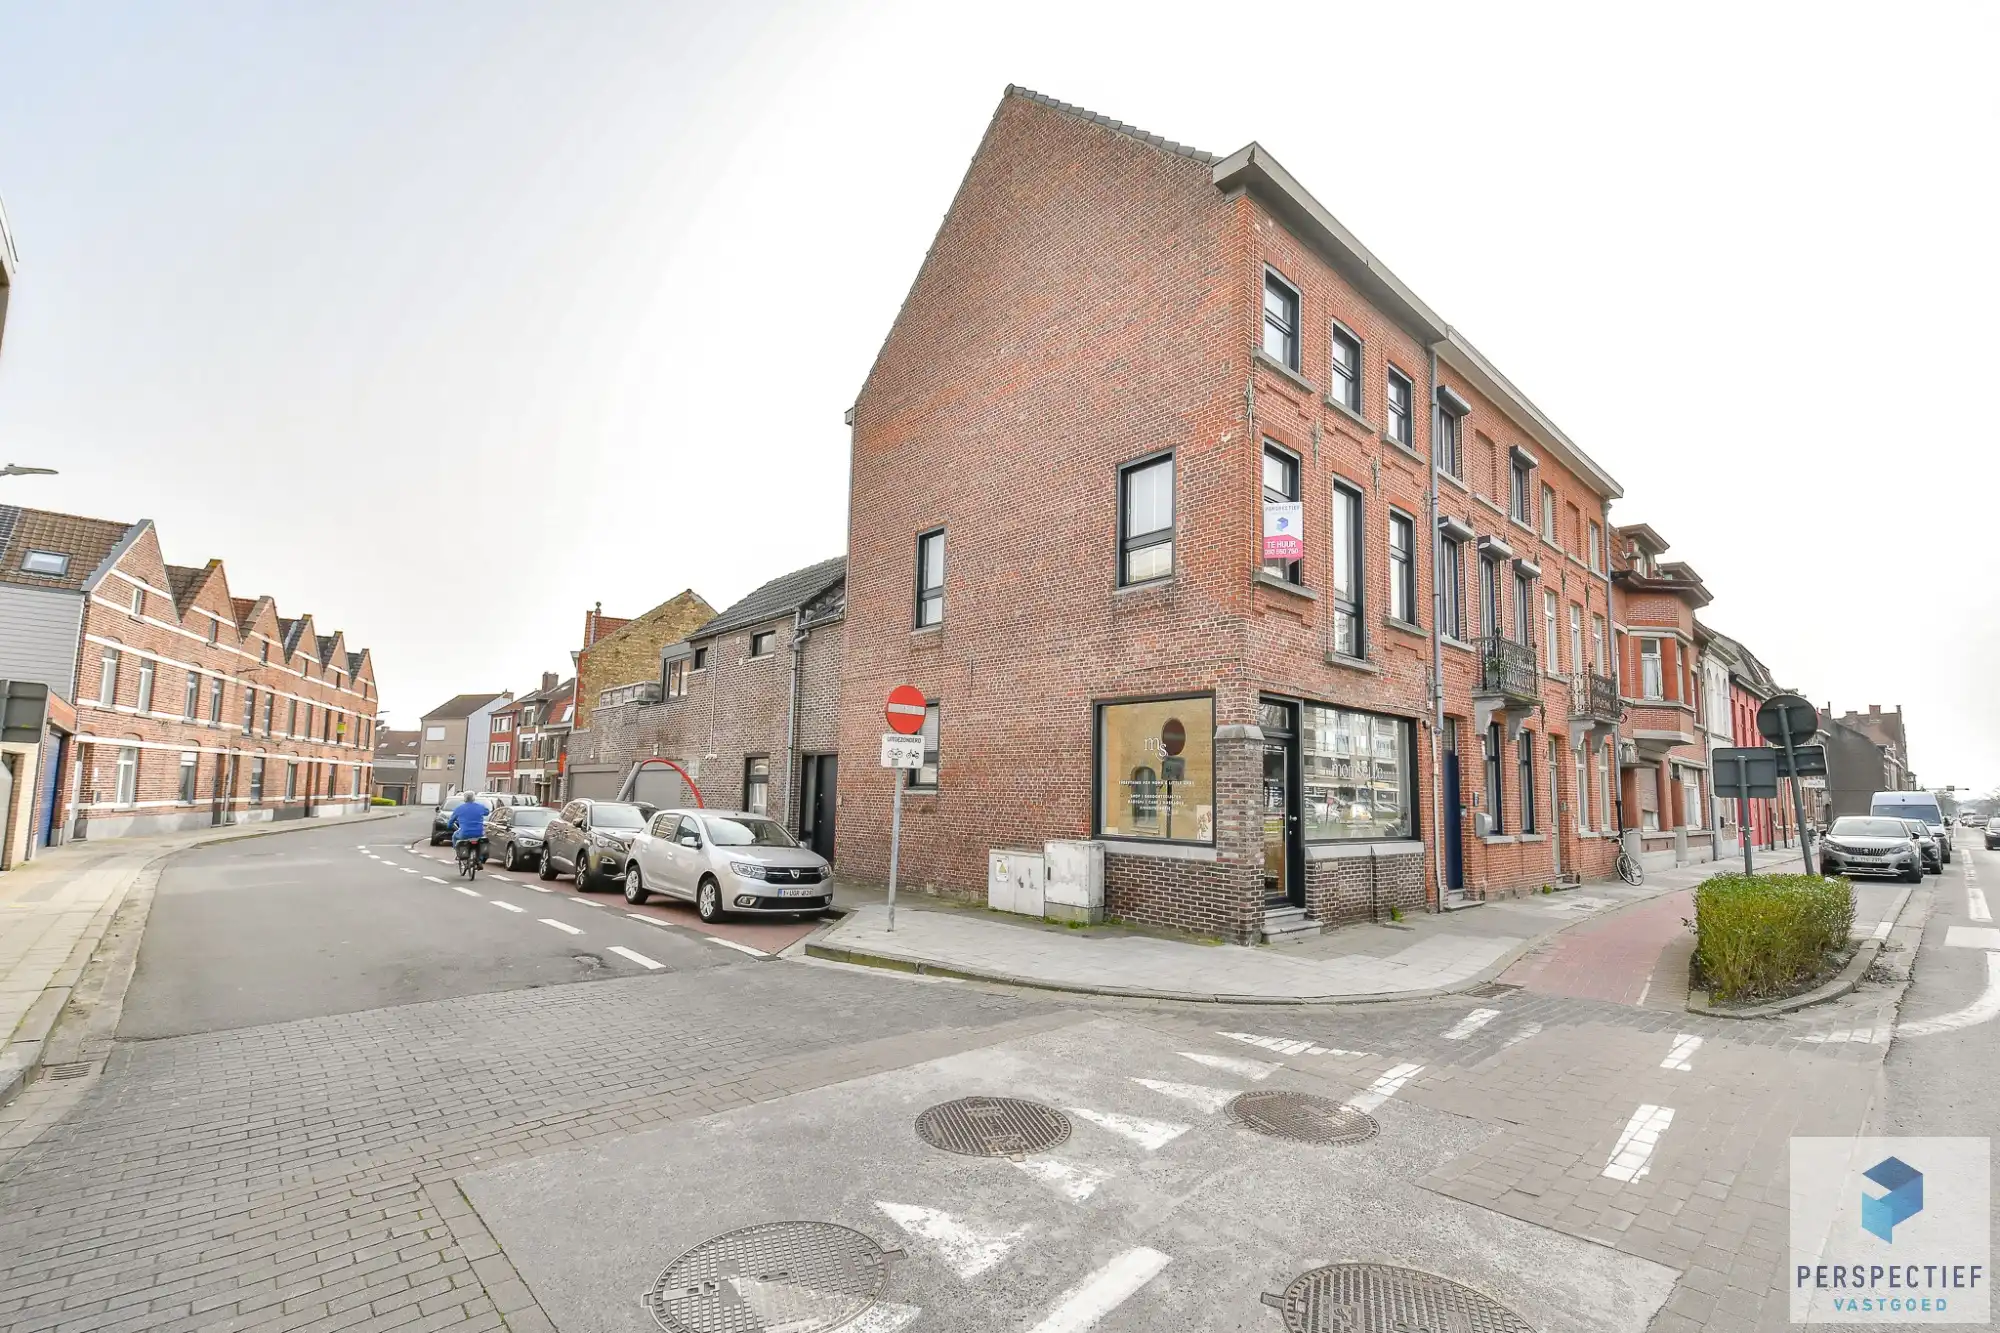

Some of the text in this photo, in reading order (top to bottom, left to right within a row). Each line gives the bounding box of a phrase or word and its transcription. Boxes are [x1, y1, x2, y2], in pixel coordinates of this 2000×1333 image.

[1266, 540, 1296, 549] TE HUUR
[887, 736, 922, 744] UITGEZONDERD
